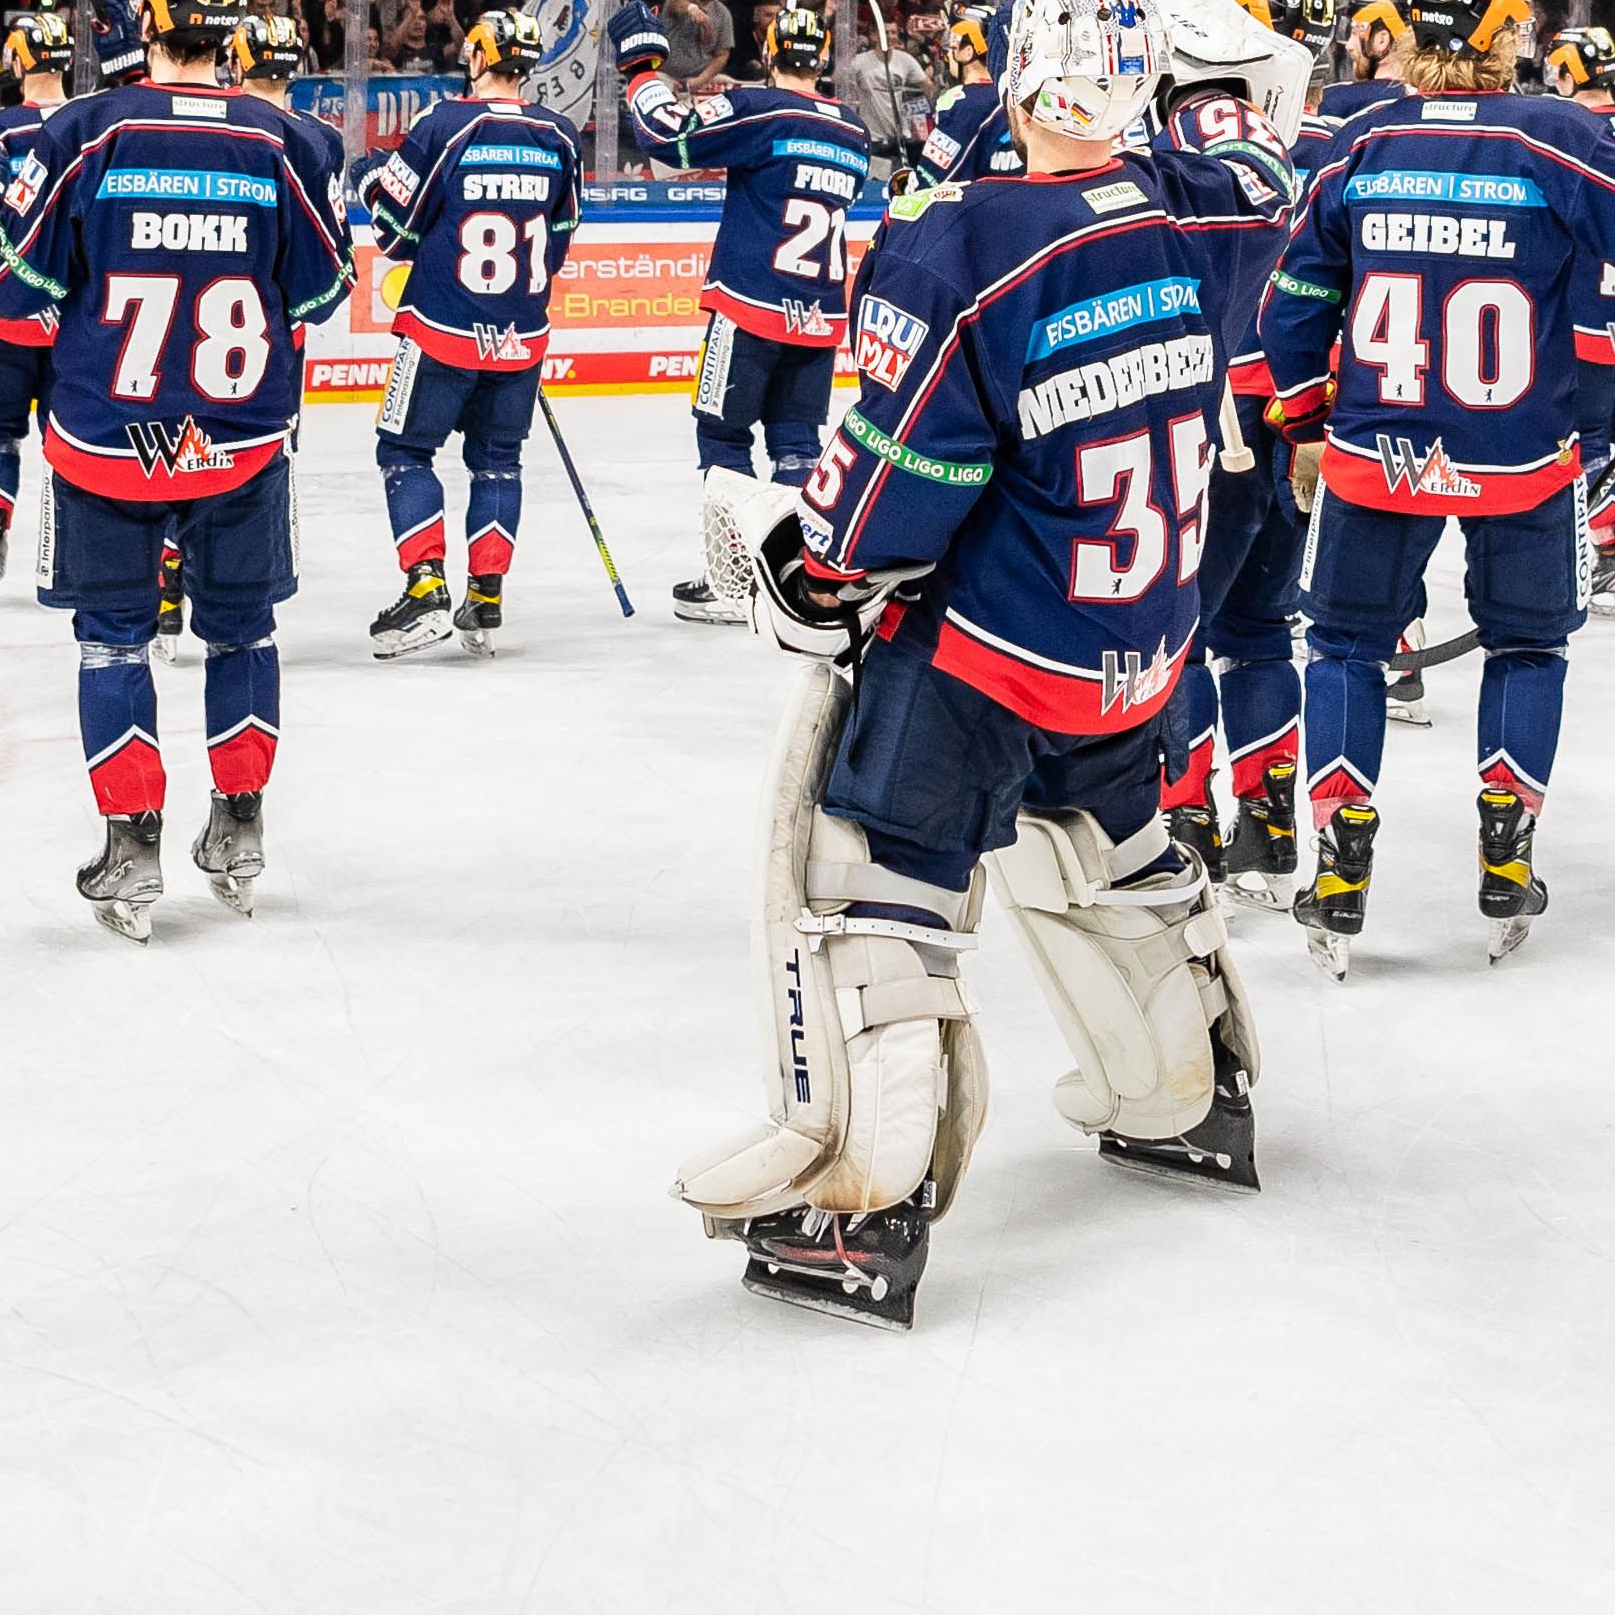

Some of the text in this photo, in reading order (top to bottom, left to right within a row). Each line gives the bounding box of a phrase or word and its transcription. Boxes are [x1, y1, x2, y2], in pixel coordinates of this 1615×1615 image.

[205, 15, 239, 26] netgo
[1422, 10, 1454, 25] netgo
[787, 140, 834, 159] EISBÄREN
[107, 170, 199, 195] EISBÄREN
[464, 174, 550, 202] STREU
[1459, 179, 1528, 202] STROM
[131, 212, 247, 252] BOKK
[458, 211, 549, 295] 81
[774, 199, 845, 282] 21
[1362, 213, 1516, 259] GEIBEL
[18, 266, 44, 286] LIGO
[1301, 283, 1329, 298] LIGO
[101, 274, 271, 403] 78
[1045, 293, 1143, 350] EISBÄREN
[1351, 273, 1535, 410] 40
[866, 430, 902, 460] LIGO
[903, 450, 945, 479] LIGO
[947, 465, 984, 485] LIGO
[1069, 409, 1213, 604] 35
[779, 949, 810, 1105] TRUE
